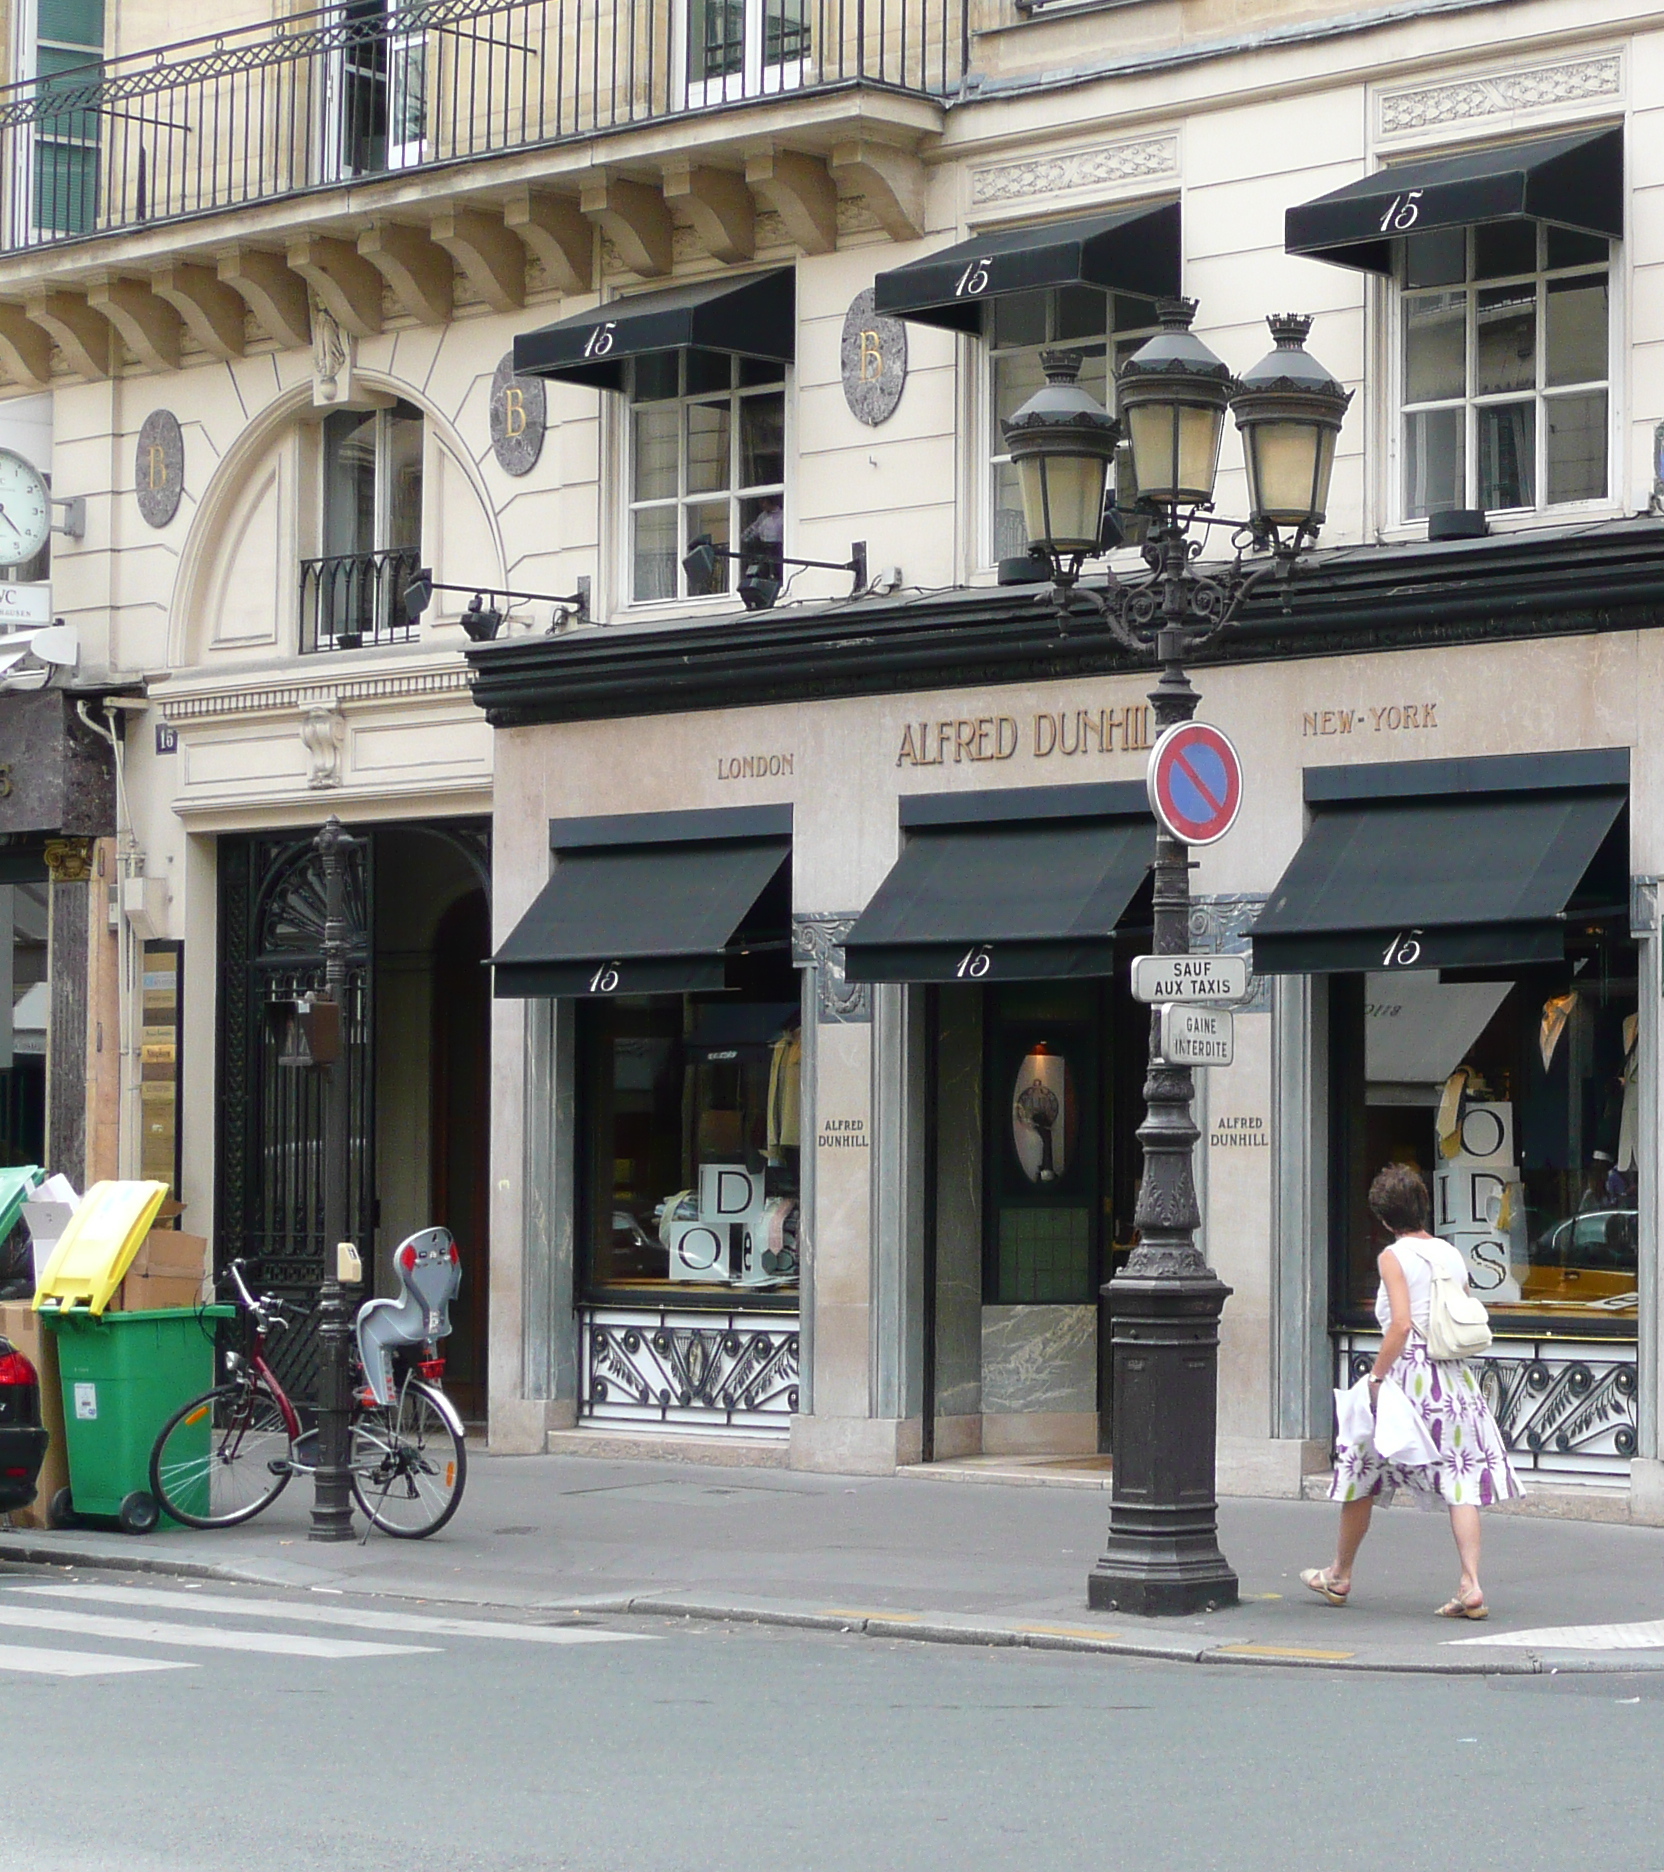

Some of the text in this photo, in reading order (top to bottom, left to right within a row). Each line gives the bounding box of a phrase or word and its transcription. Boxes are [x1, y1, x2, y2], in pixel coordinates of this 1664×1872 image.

[1379, 190, 1424, 232] 15
[954, 257, 993, 297] 15
[584, 320, 617, 357] 15
[859, 330, 884, 383] B
[504, 386, 528, 438] B
[146, 445, 167, 491] B
[160, 729, 174, 749] 15
[896, 704, 1157, 767] ALFRED DUNHIL
[717, 752, 795, 780] LONDON
[956, 944, 993, 978] 15
[1382, 929, 1424, 966] 15
[588, 961, 621, 992] 15
[1173, 962, 1212, 977] SAUF
[1154, 979, 1231, 996] AUX TAXIS
[1186, 1017, 1217, 1035] GAINE
[1174, 1038, 1228, 1058] INTERDITE
[825, 1120, 864, 1131] ALFRED
[1218, 1117, 1263, 1129] ALFRED
[818, 1135, 869, 1147] DUNHILL
[1210, 1133, 1269, 1147] DUNHILL
